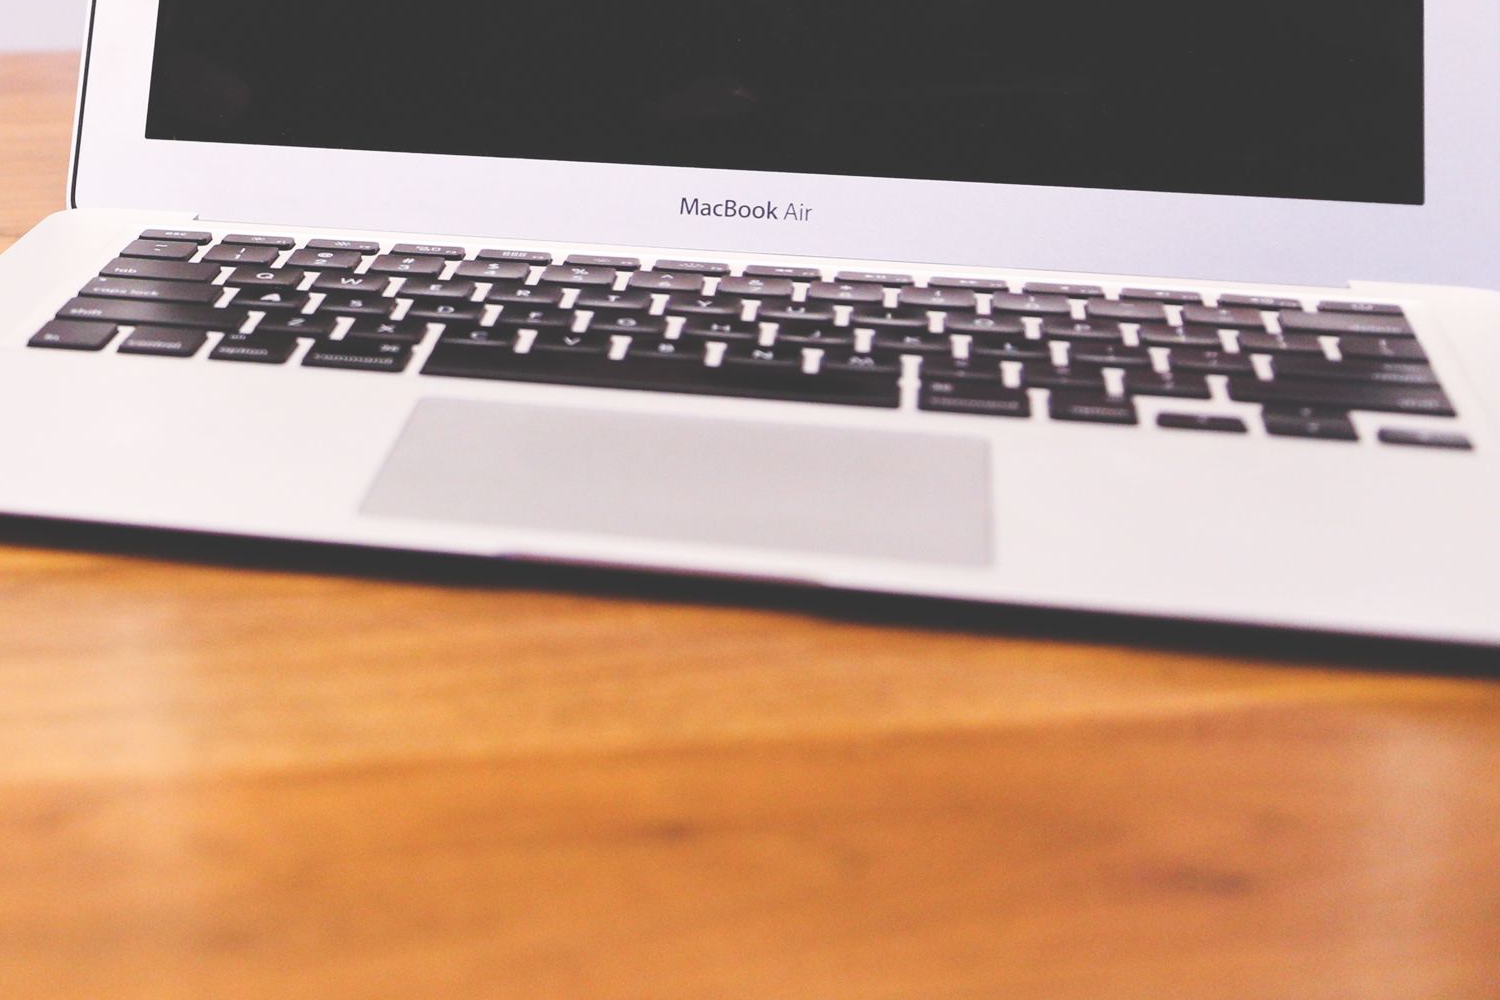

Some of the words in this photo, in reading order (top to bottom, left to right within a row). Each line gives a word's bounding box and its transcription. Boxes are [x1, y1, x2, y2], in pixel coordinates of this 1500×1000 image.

[679, 197, 779, 220] MacBook
[783, 202, 813, 222] Air
[256, 272, 275, 280] Q
[340, 277, 363, 285] W
[377, 324, 396, 334] X
